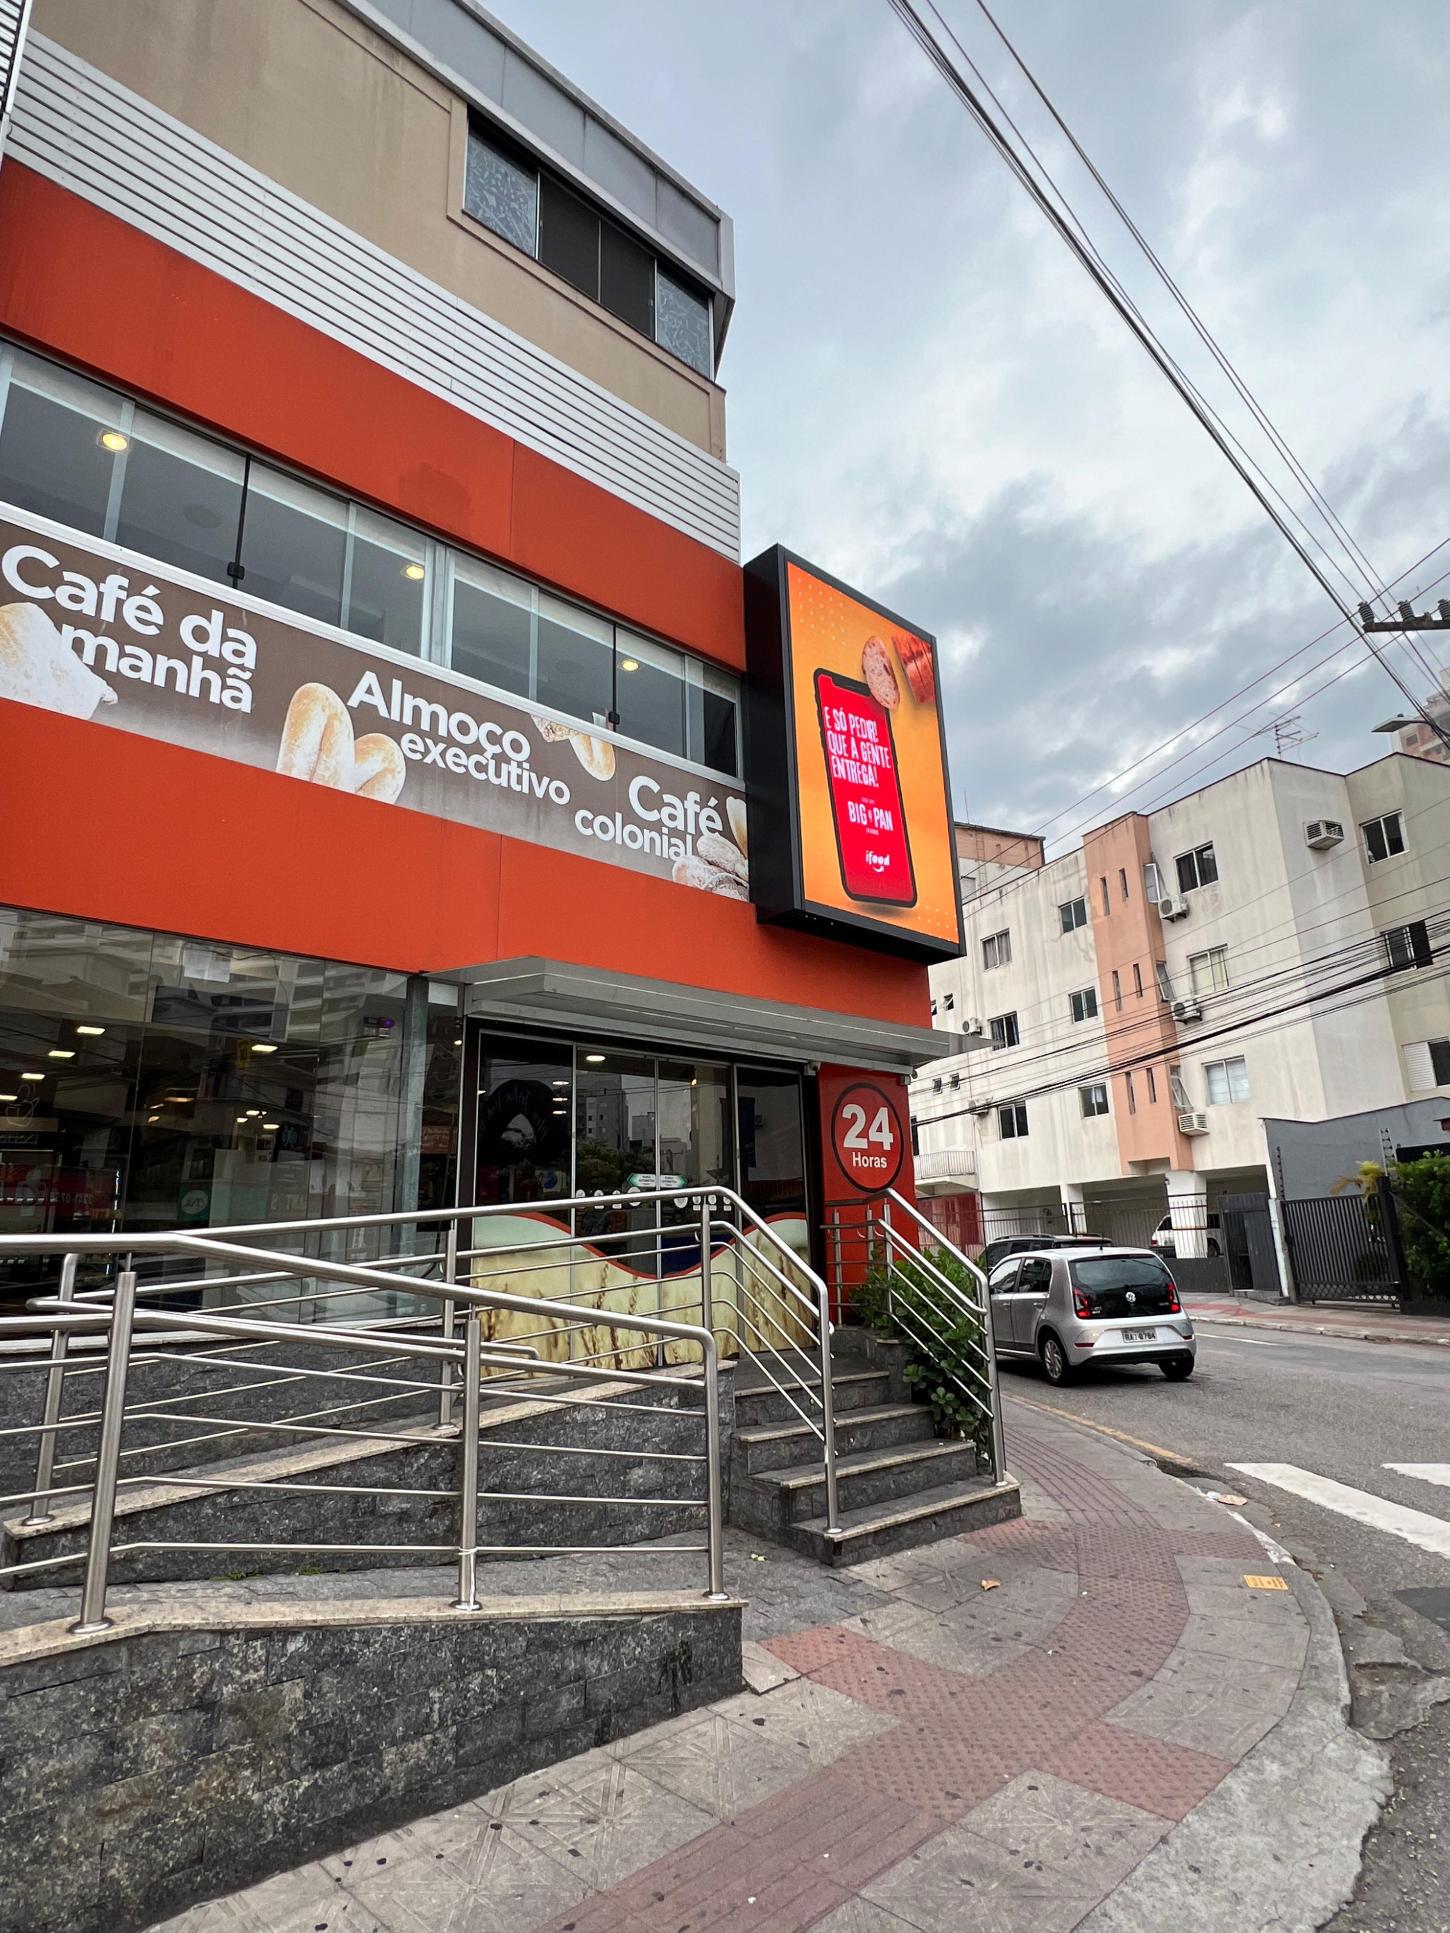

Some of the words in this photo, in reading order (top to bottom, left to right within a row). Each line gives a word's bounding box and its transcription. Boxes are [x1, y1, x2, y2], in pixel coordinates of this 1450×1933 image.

[2, 545, 164, 635] Café
[180, 609, 257, 670] da
[61, 624, 253, 713] manhã
[347, 671, 531, 762] Almoço
[832, 707, 847, 731] SÓ
[848, 713, 879, 742] PEDIR!
[400, 733, 571, 805] executivo
[827, 730, 848, 756] QUE
[851, 737, 859, 759] A
[860, 741, 891, 768] GENTE
[831, 756, 879, 788] ENTREGA!
[628, 776, 723, 836] Café
[847, 801, 867, 825] BIG
[873, 807, 894, 831] PAN
[574, 809, 694, 859] colonial
[842, 1104, 893, 1150] 24
[852, 1151, 887, 1168] Horas
